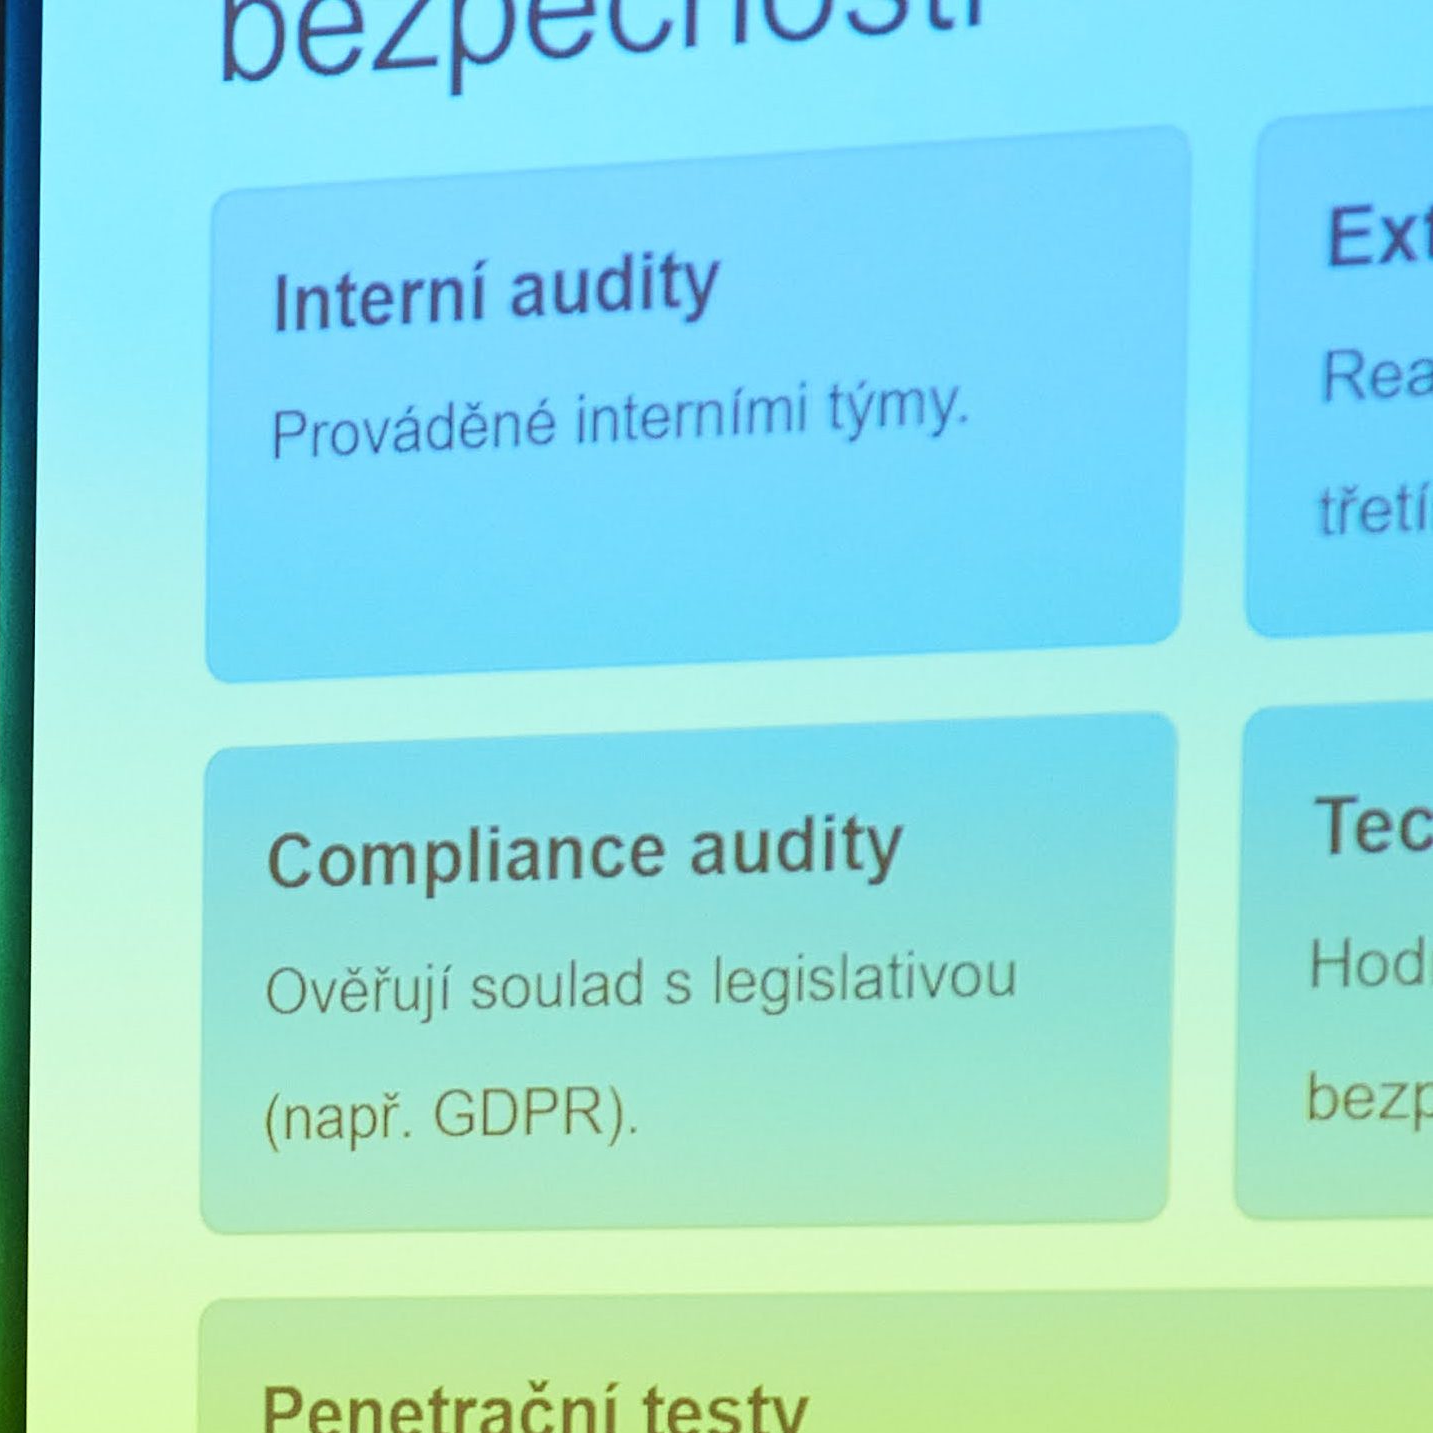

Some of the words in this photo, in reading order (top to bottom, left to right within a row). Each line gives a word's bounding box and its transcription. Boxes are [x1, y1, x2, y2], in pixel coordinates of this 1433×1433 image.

[223, 0, 986, 98] bezpen
[277, 260, 485, 331] Interní
[512, 252, 719, 323] audity
[275, 399, 555, 459] Prováděné
[578, 382, 806, 444] interními
[829, 381, 967, 442] týmy.
[1319, 481, 1433, 536] třetí
[269, 826, 664, 899] Compliance
[692, 815, 903, 885] audity
[267, 964, 451, 1023] Ověřují
[472, 958, 642, 1009] soulad
[667, 970, 691, 1004] s
[716, 951, 1015, 1015] legislativou
[1312, 935, 1433, 988] Hod
[266, 1093, 410, 1152] (např.
[435, 1087, 636, 1146] GDPR).
